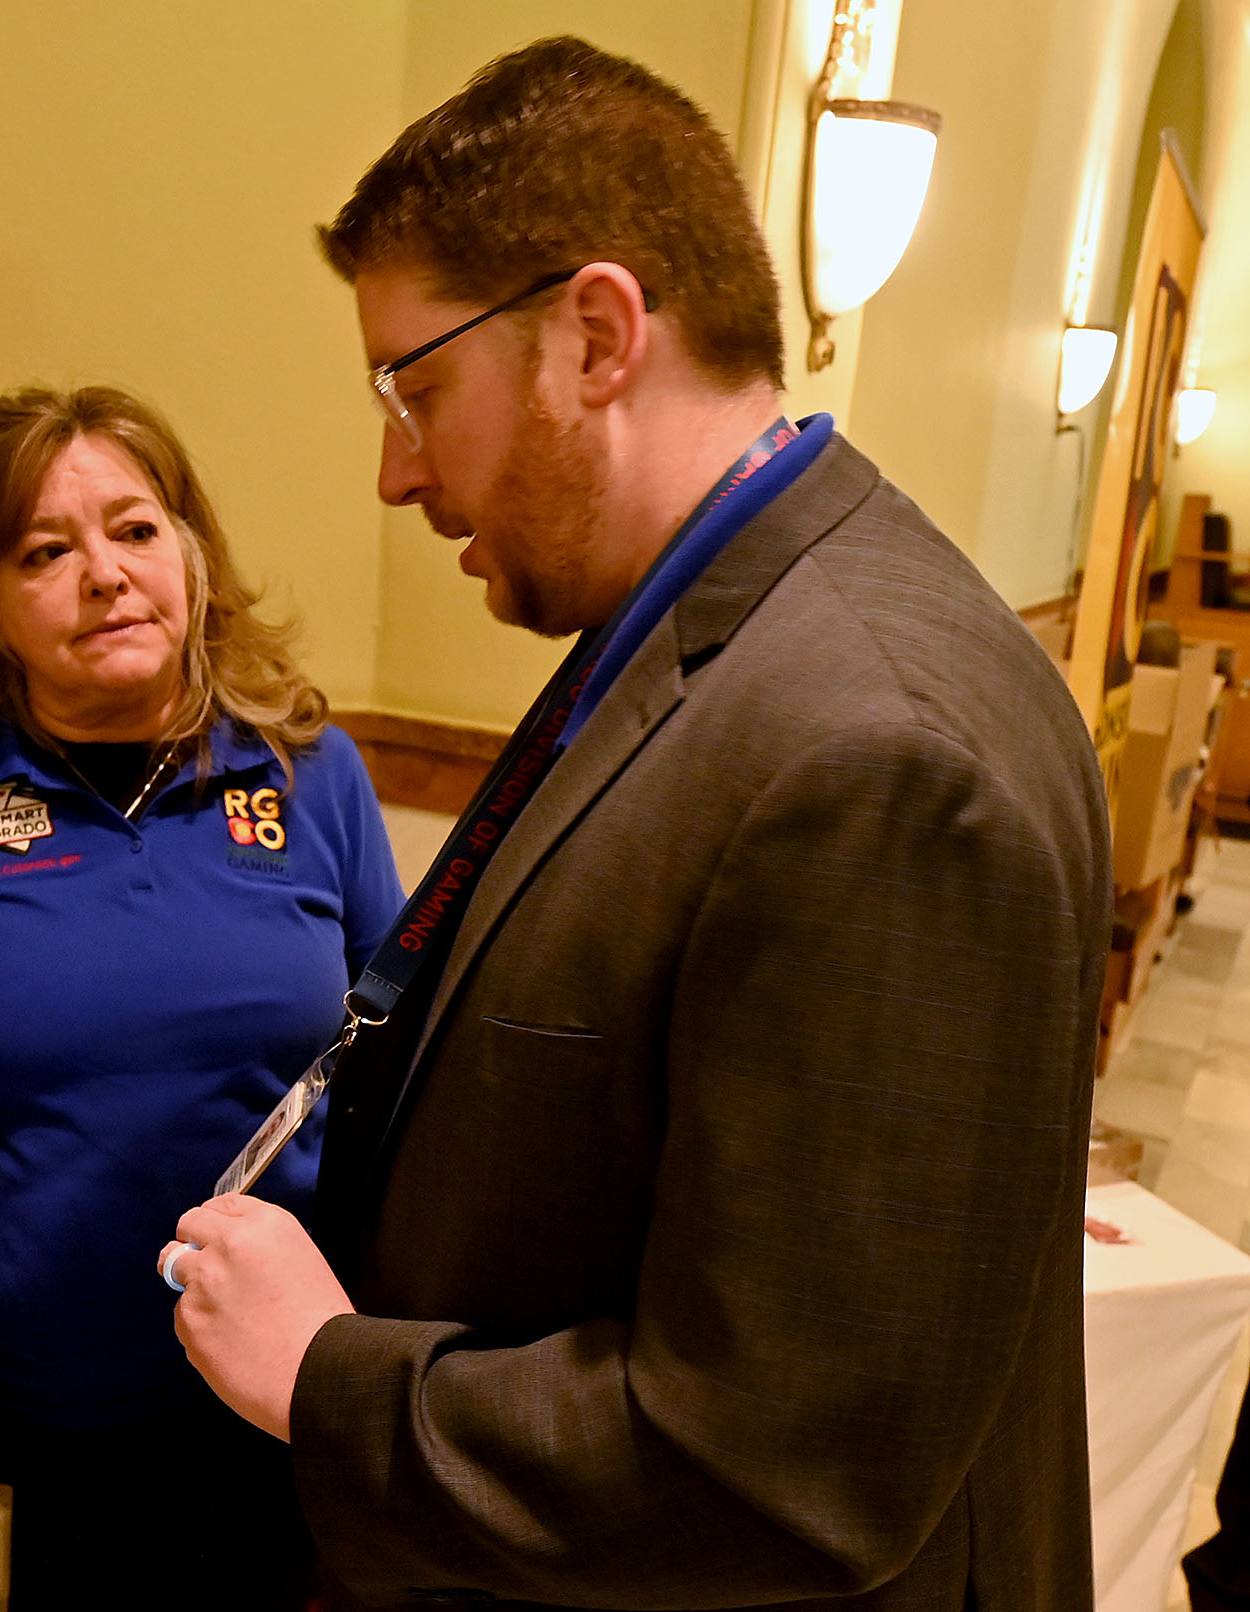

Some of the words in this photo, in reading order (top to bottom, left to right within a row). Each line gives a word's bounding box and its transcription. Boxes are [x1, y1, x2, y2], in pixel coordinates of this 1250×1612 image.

[224, 788, 280, 819] RG
[468, 821, 498, 857] OF
[400, 858, 474, 951] GAMING
